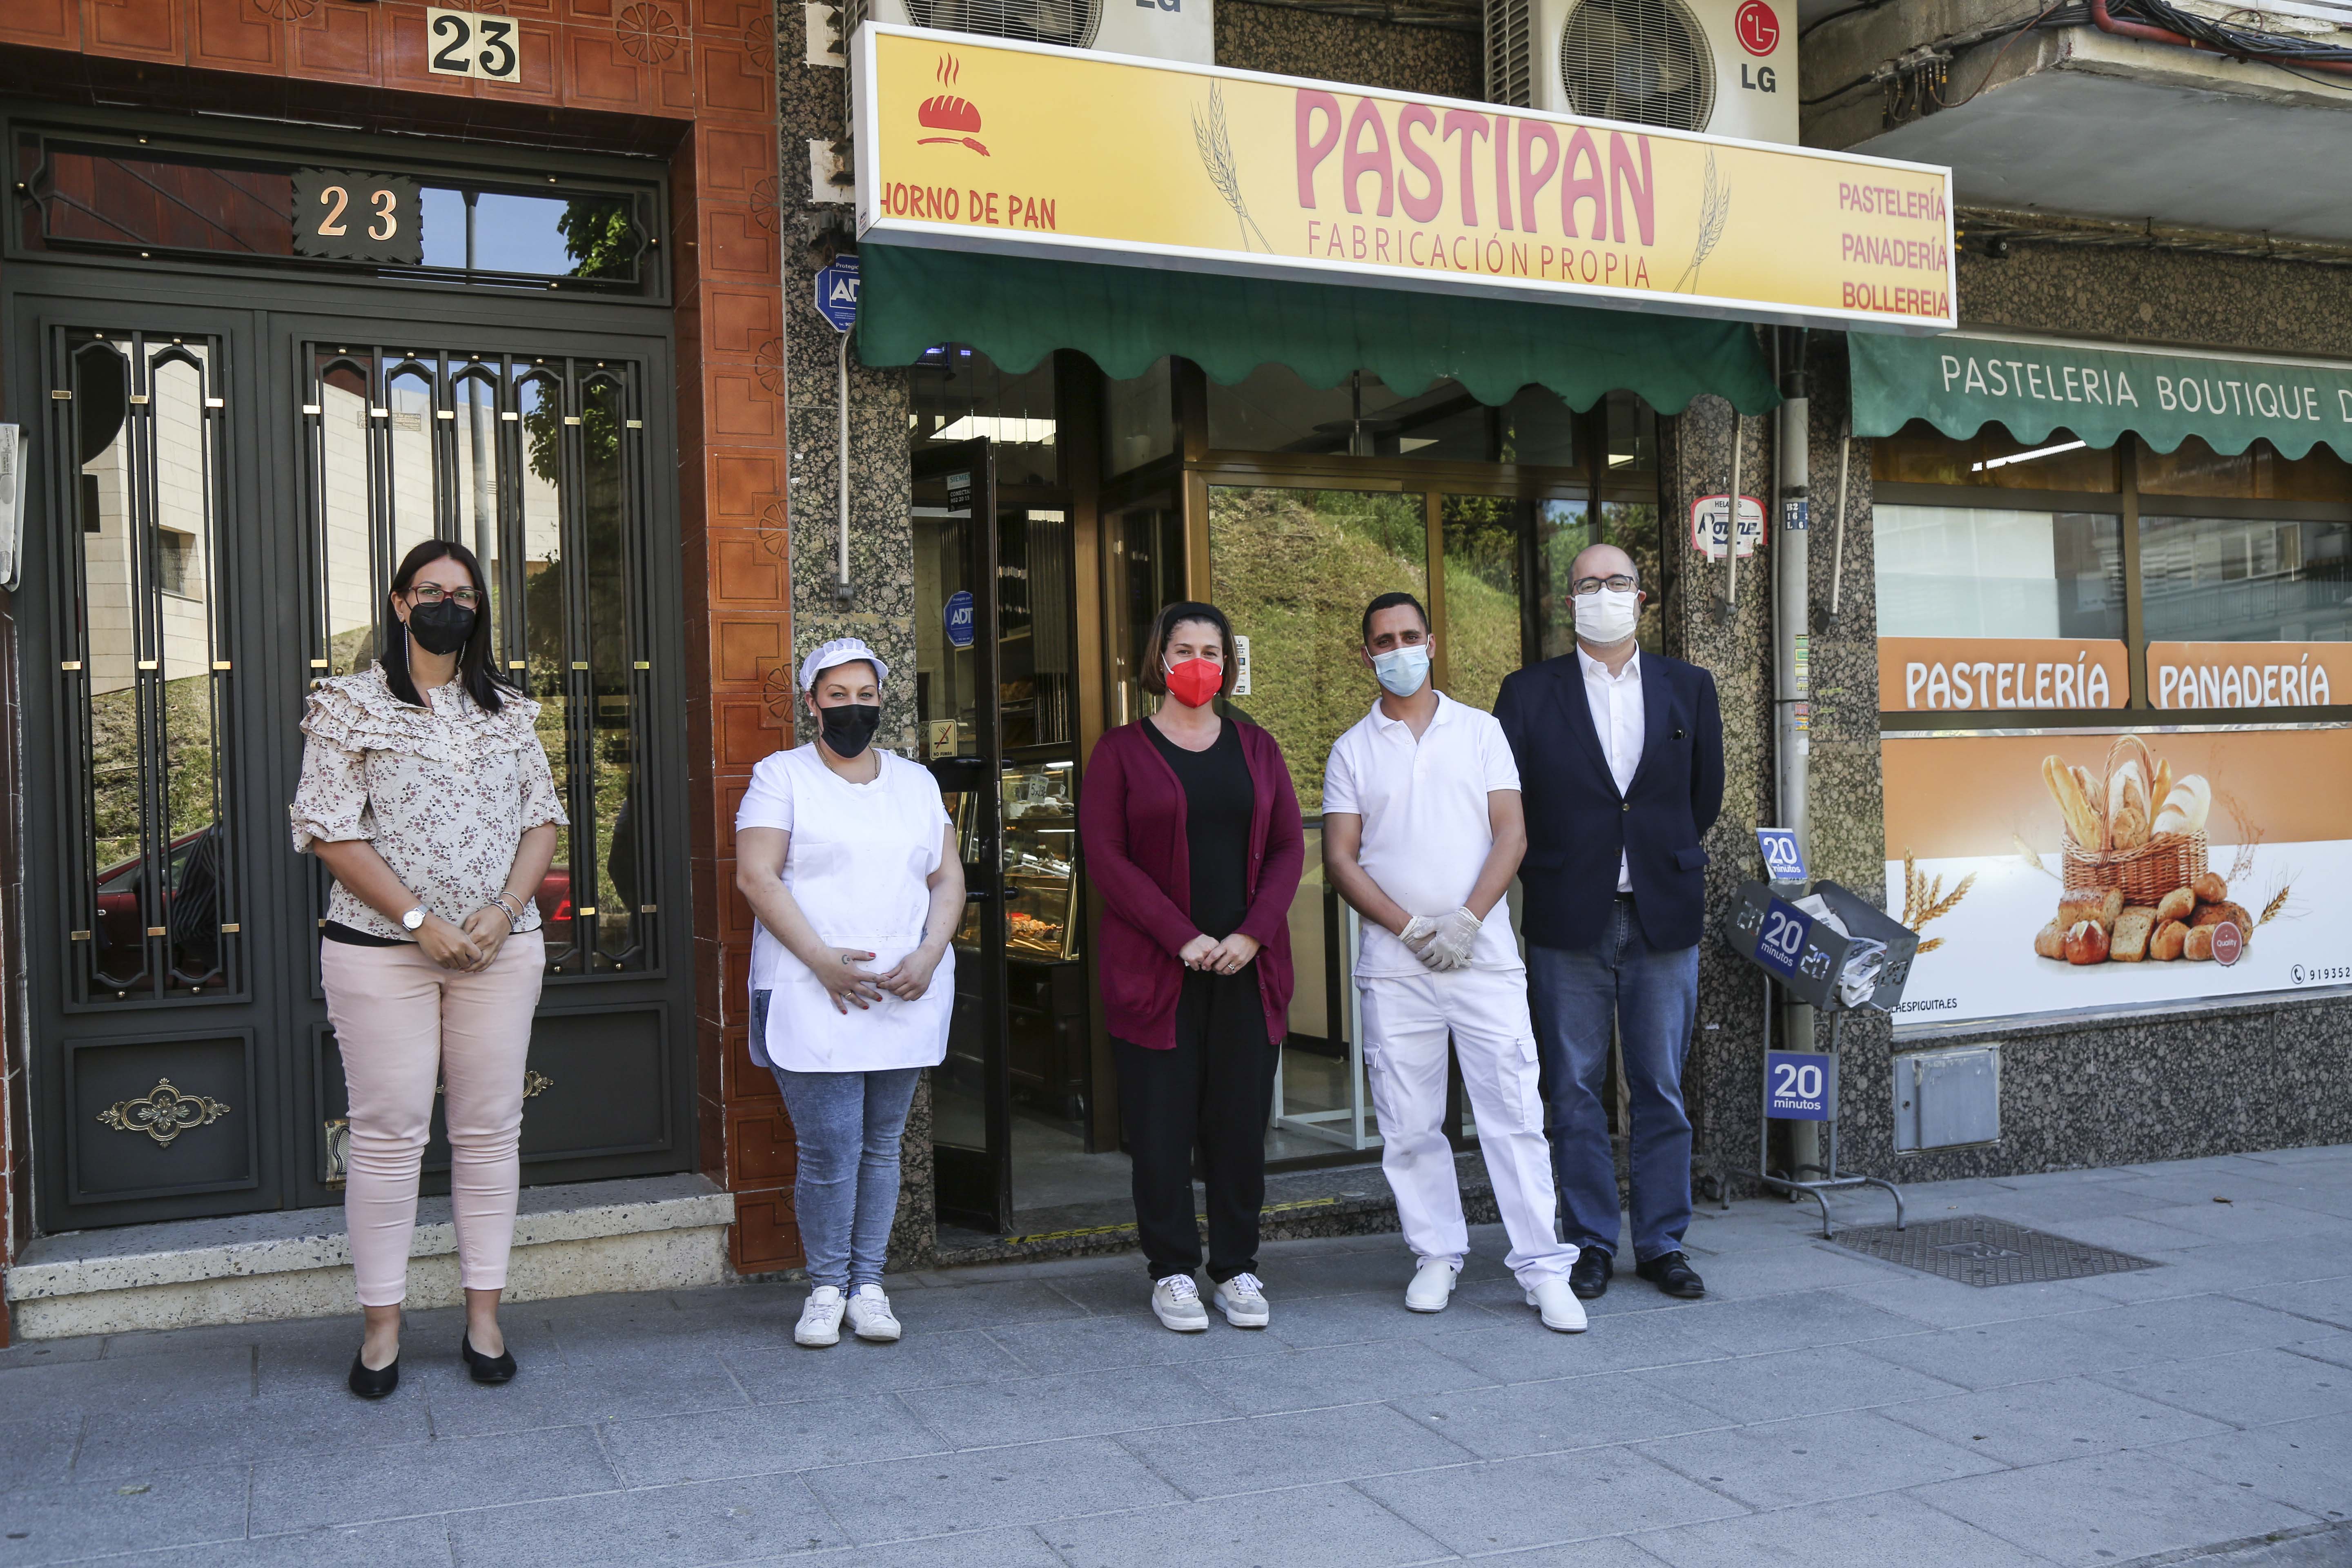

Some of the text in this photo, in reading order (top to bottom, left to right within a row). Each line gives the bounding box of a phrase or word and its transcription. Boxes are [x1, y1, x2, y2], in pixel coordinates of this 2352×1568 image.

[433, 15, 515, 76] 23
[1742, 63, 1776, 93] LG
[1296, 87, 1655, 246] PASTIPAN
[318, 186, 397, 241] 23
[969, 190, 999, 224] DE
[1009, 195, 1056, 230] PAN
[1839, 183, 1946, 222] PASTELERÍA
[1308, 220, 1650, 288] FABRICACIÓN PROPIA
[1842, 233, 1947, 273] PANADERÍA
[1843, 282, 1949, 318] BOLLEREIA
[1941, 354, 2139, 408] PASTELERIA
[2156, 375, 2320, 421] BOUTIQUE
[1786, 503, 1799, 511] B2
[951, 608, 973, 625] ADT
[1906, 650, 2109, 709] PASTELERÍA
[2159, 653, 2330, 709] PANADERÍA
[1764, 837, 1797, 864] 20
[1765, 911, 1803, 954] 20
[2217, 939, 2237, 947] Quality
[1761, 942, 1793, 967] minutos
[1800, 944, 1831, 980] 20
[1775, 1063, 1822, 1099] 20
[1774, 1098, 1821, 1110] minutos
